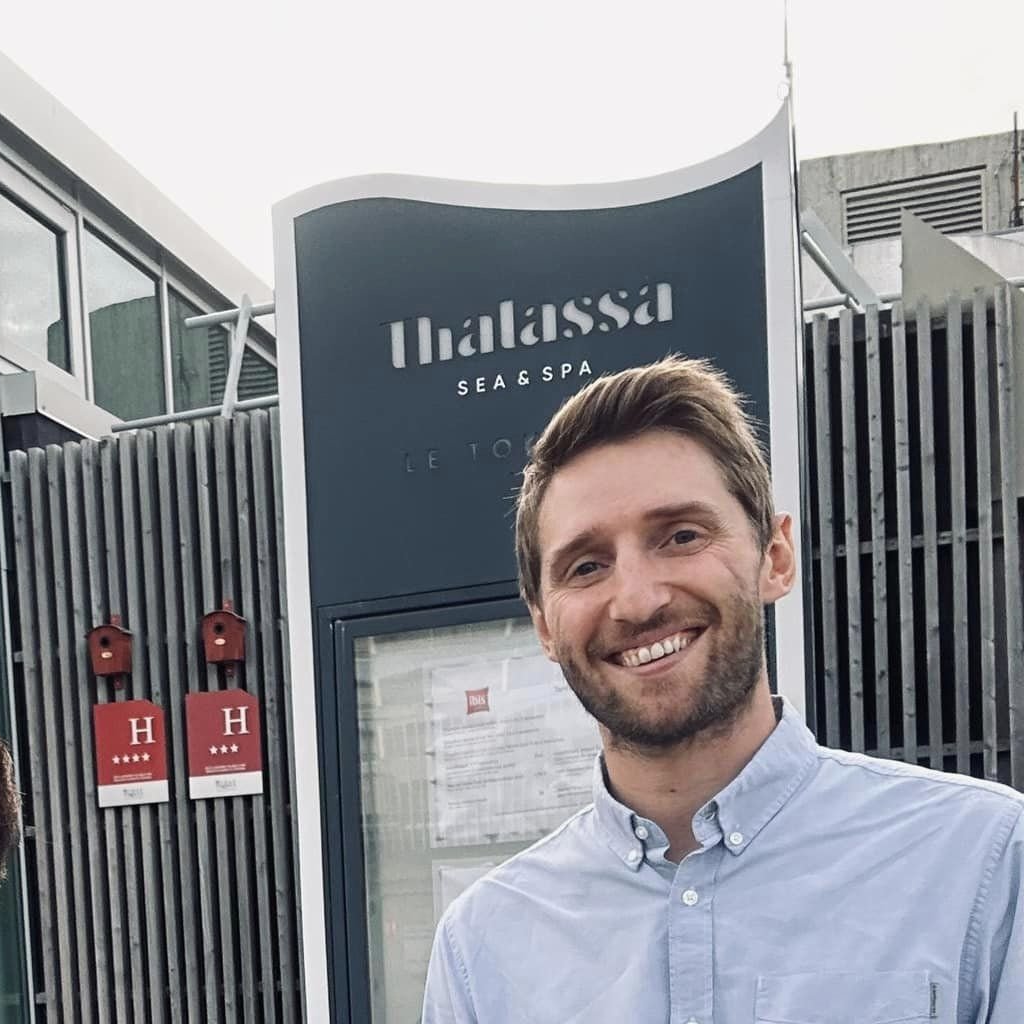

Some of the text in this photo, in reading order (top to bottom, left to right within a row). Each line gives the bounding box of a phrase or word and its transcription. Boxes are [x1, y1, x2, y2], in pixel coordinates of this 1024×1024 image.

[380, 283, 673, 369] Thalassa
[457, 360, 592, 396] SEA & SPA
[468, 694, 487, 706] ibis
[128, 716, 156, 745] H
[222, 706, 250, 736] H
